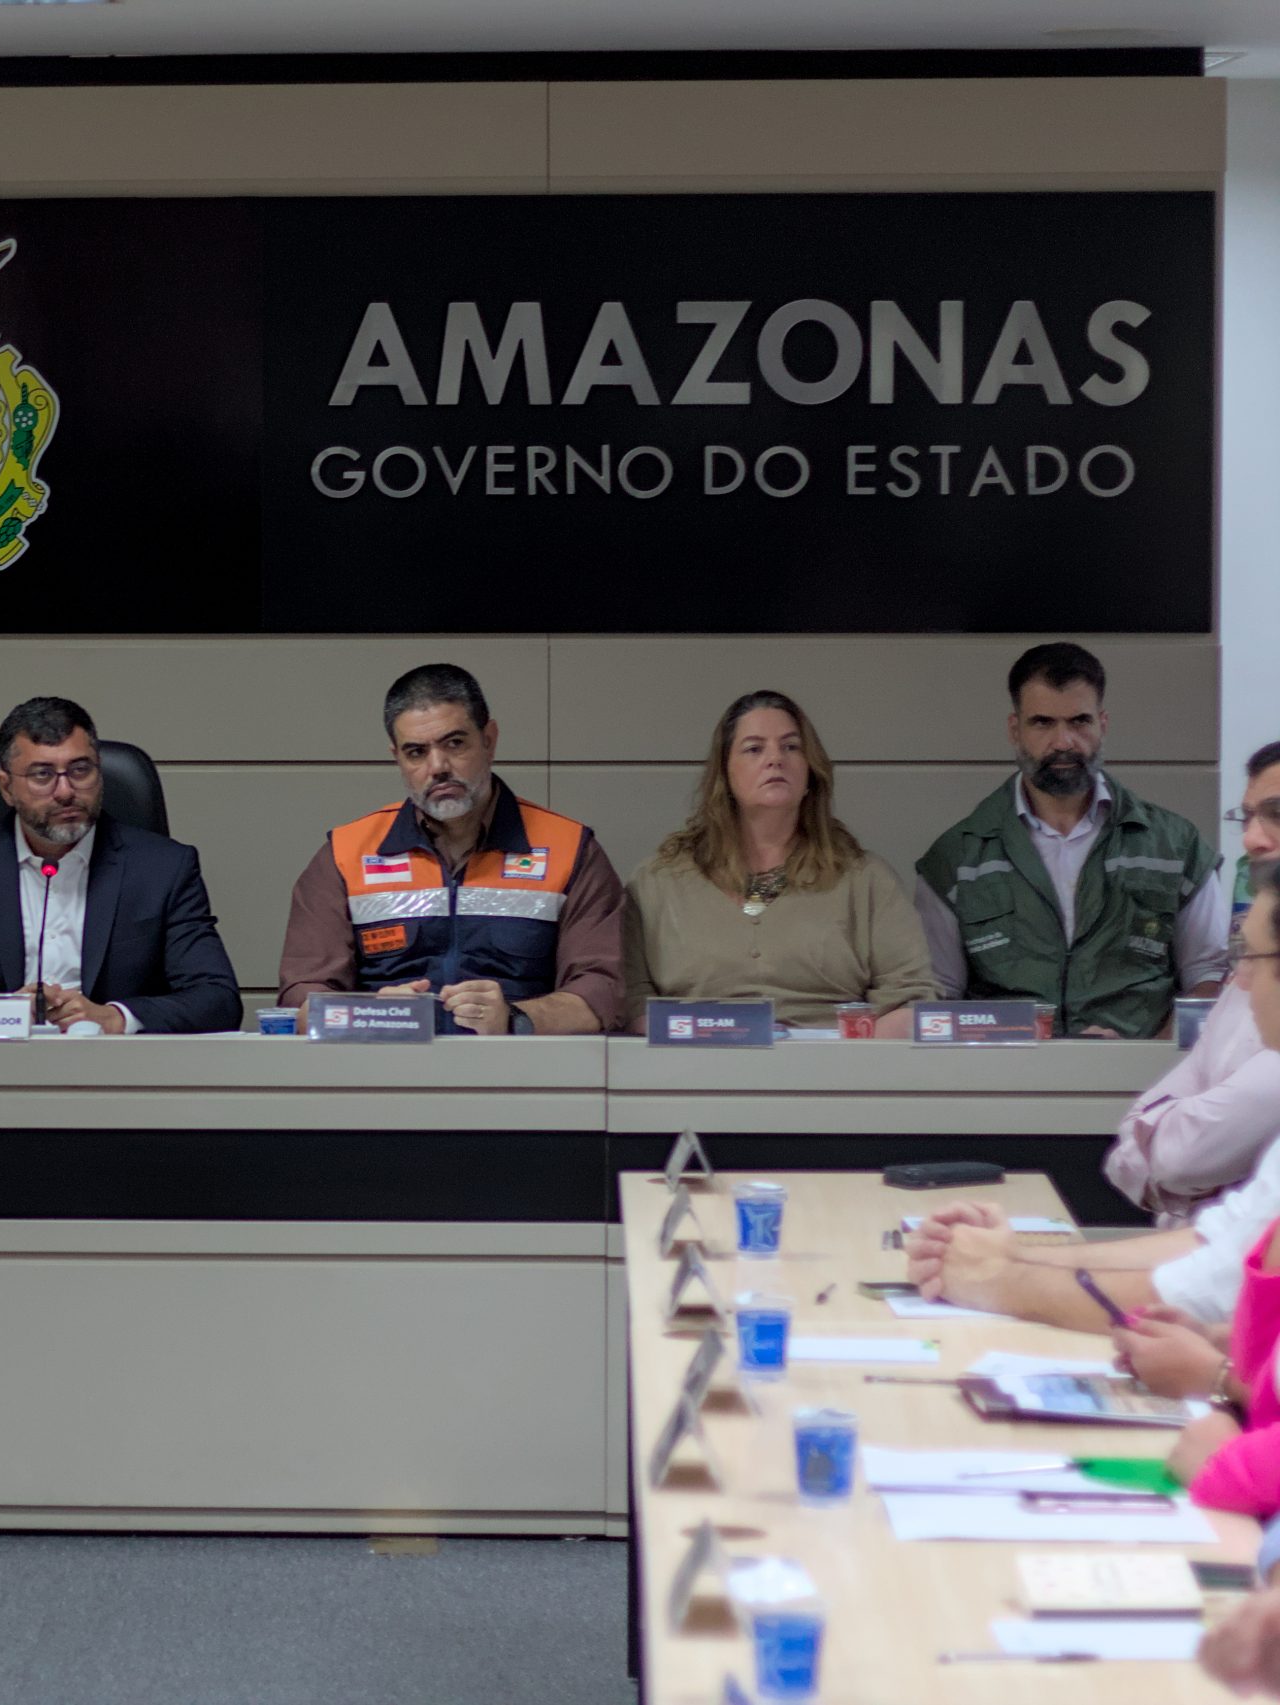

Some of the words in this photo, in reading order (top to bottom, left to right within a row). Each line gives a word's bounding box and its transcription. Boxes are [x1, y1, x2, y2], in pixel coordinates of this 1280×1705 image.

[329, 299, 1152, 405] AMAZONAS
[310, 445, 674, 498] GOVERNO
[703, 445, 810, 497] DO
[847, 445, 1136, 497] ESTADO
[353, 1006, 386, 1017] Defesa
[388, 1006, 411, 1017] Civil
[353, 1019, 366, 1029] do
[369, 1019, 419, 1030] Amazonas
[696, 1017, 735, 1027] SES-AM
[958, 1014, 997, 1026] SEMA
